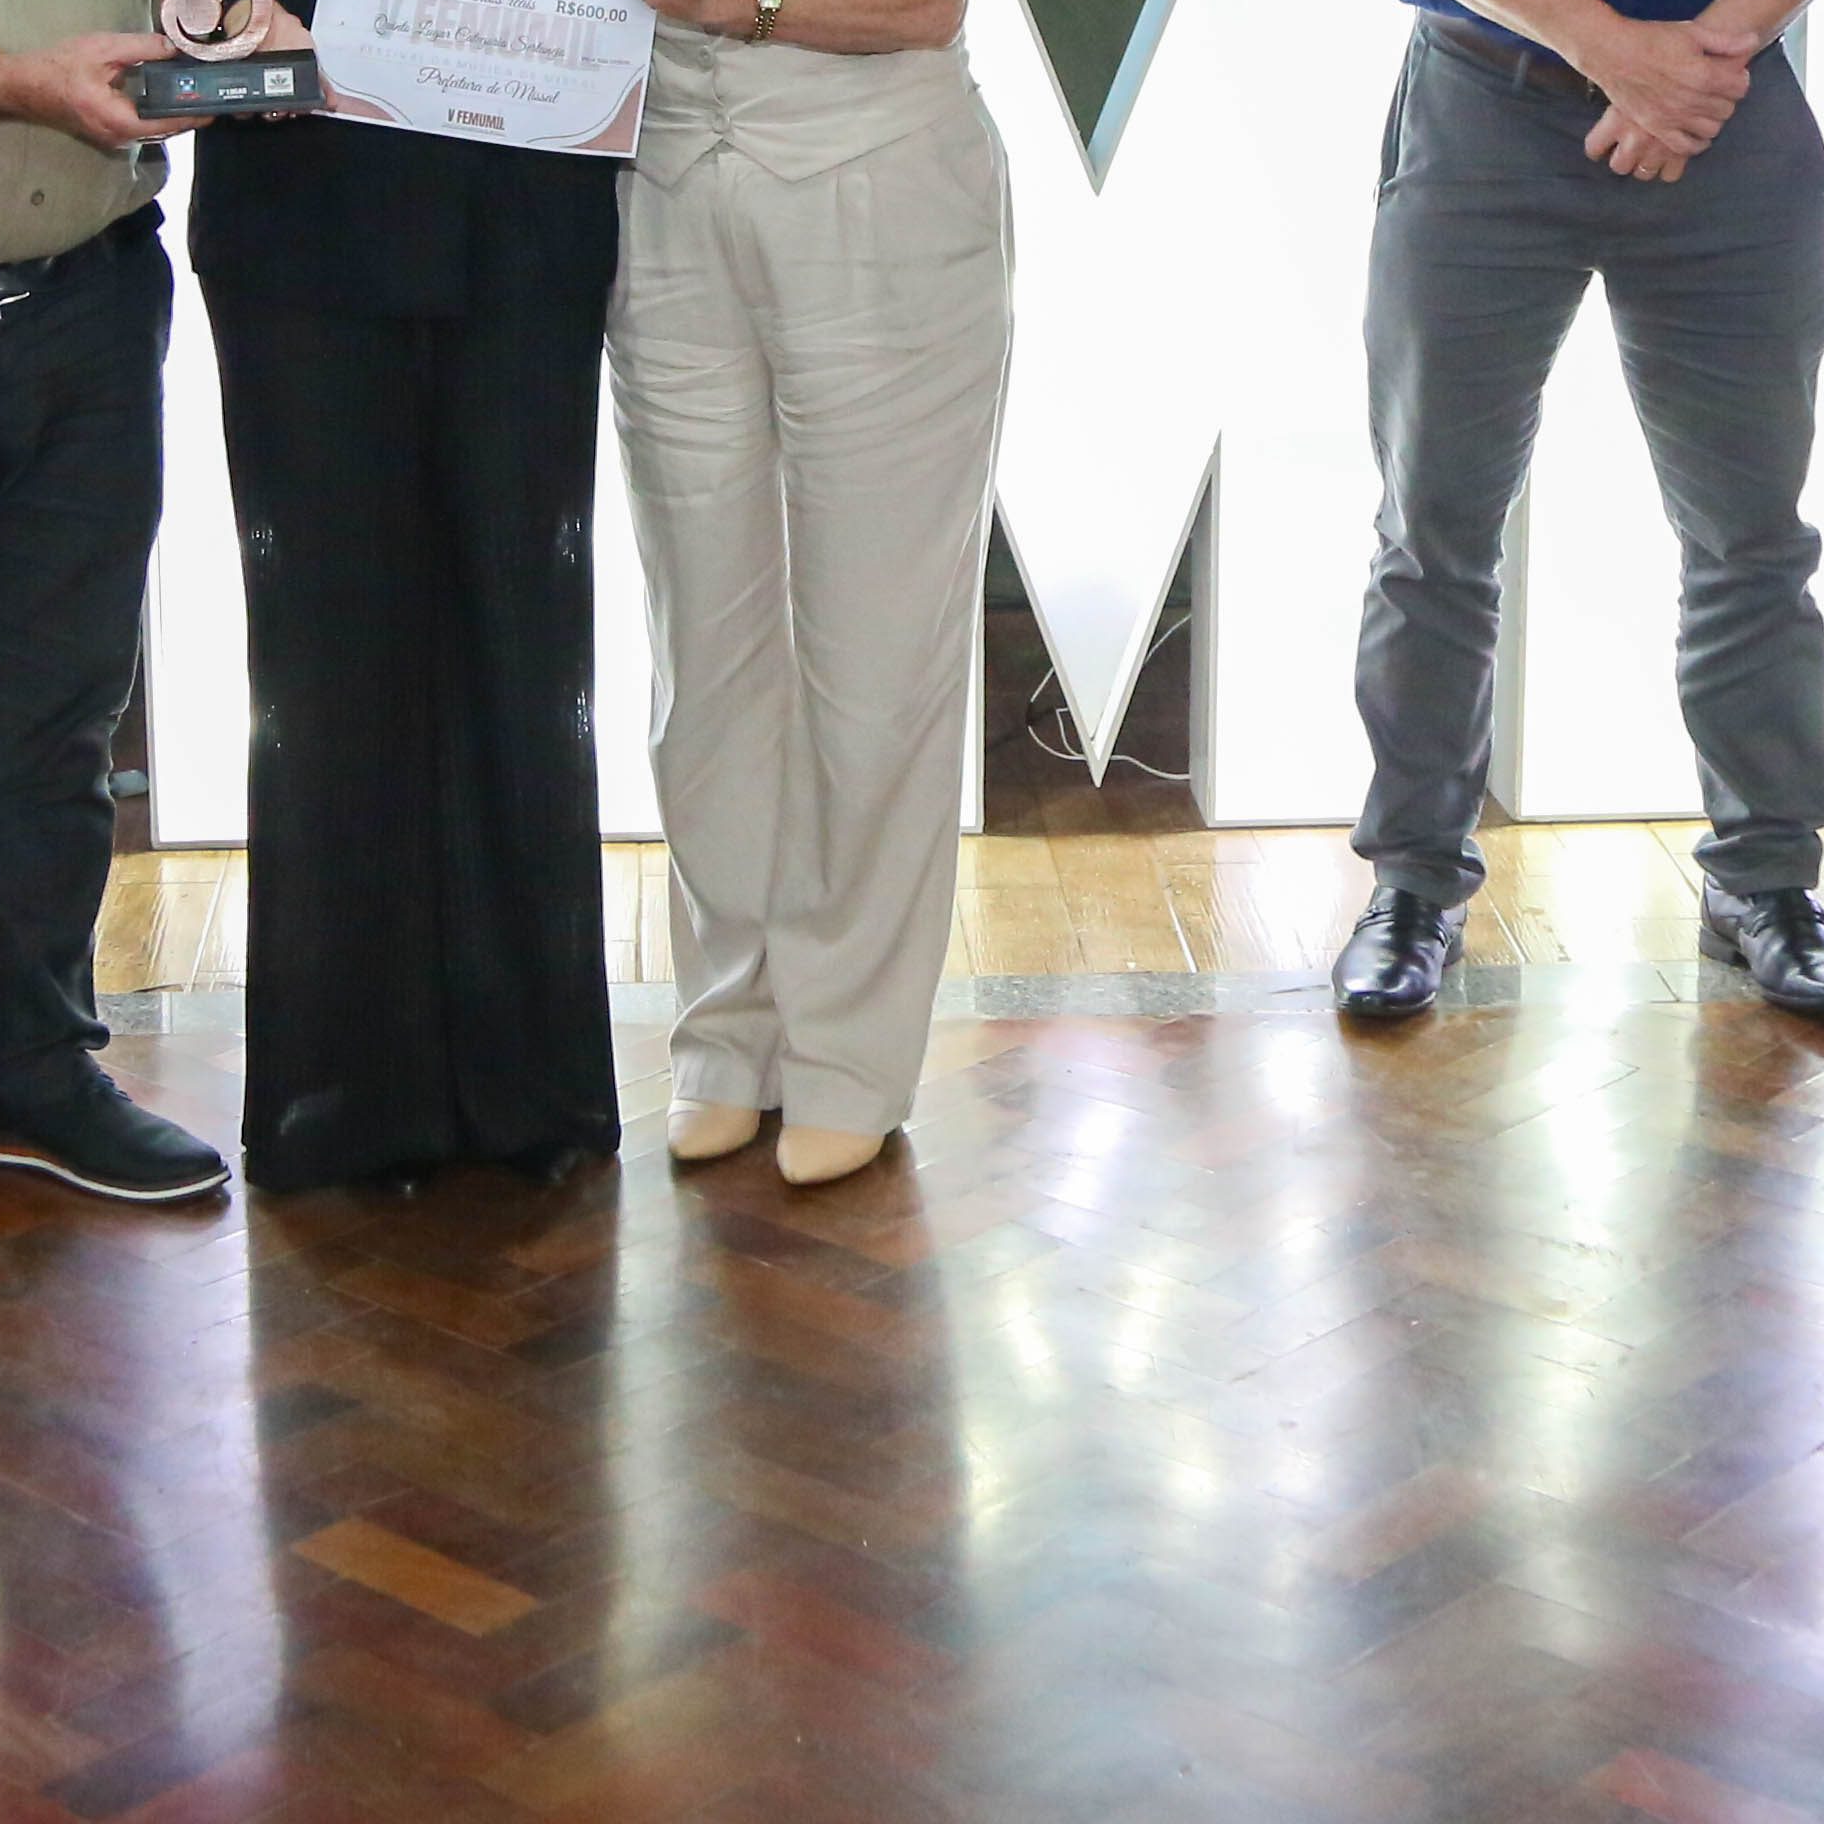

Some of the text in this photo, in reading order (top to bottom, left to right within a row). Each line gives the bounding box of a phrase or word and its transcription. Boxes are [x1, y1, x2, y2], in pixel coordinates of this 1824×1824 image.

[556, 0, 628, 24] R$600,00
[417, 65, 561, 105] Prefeitura de Missal
[447, 108, 456, 123] V
[456, 109, 505, 130] FEMUMIL
